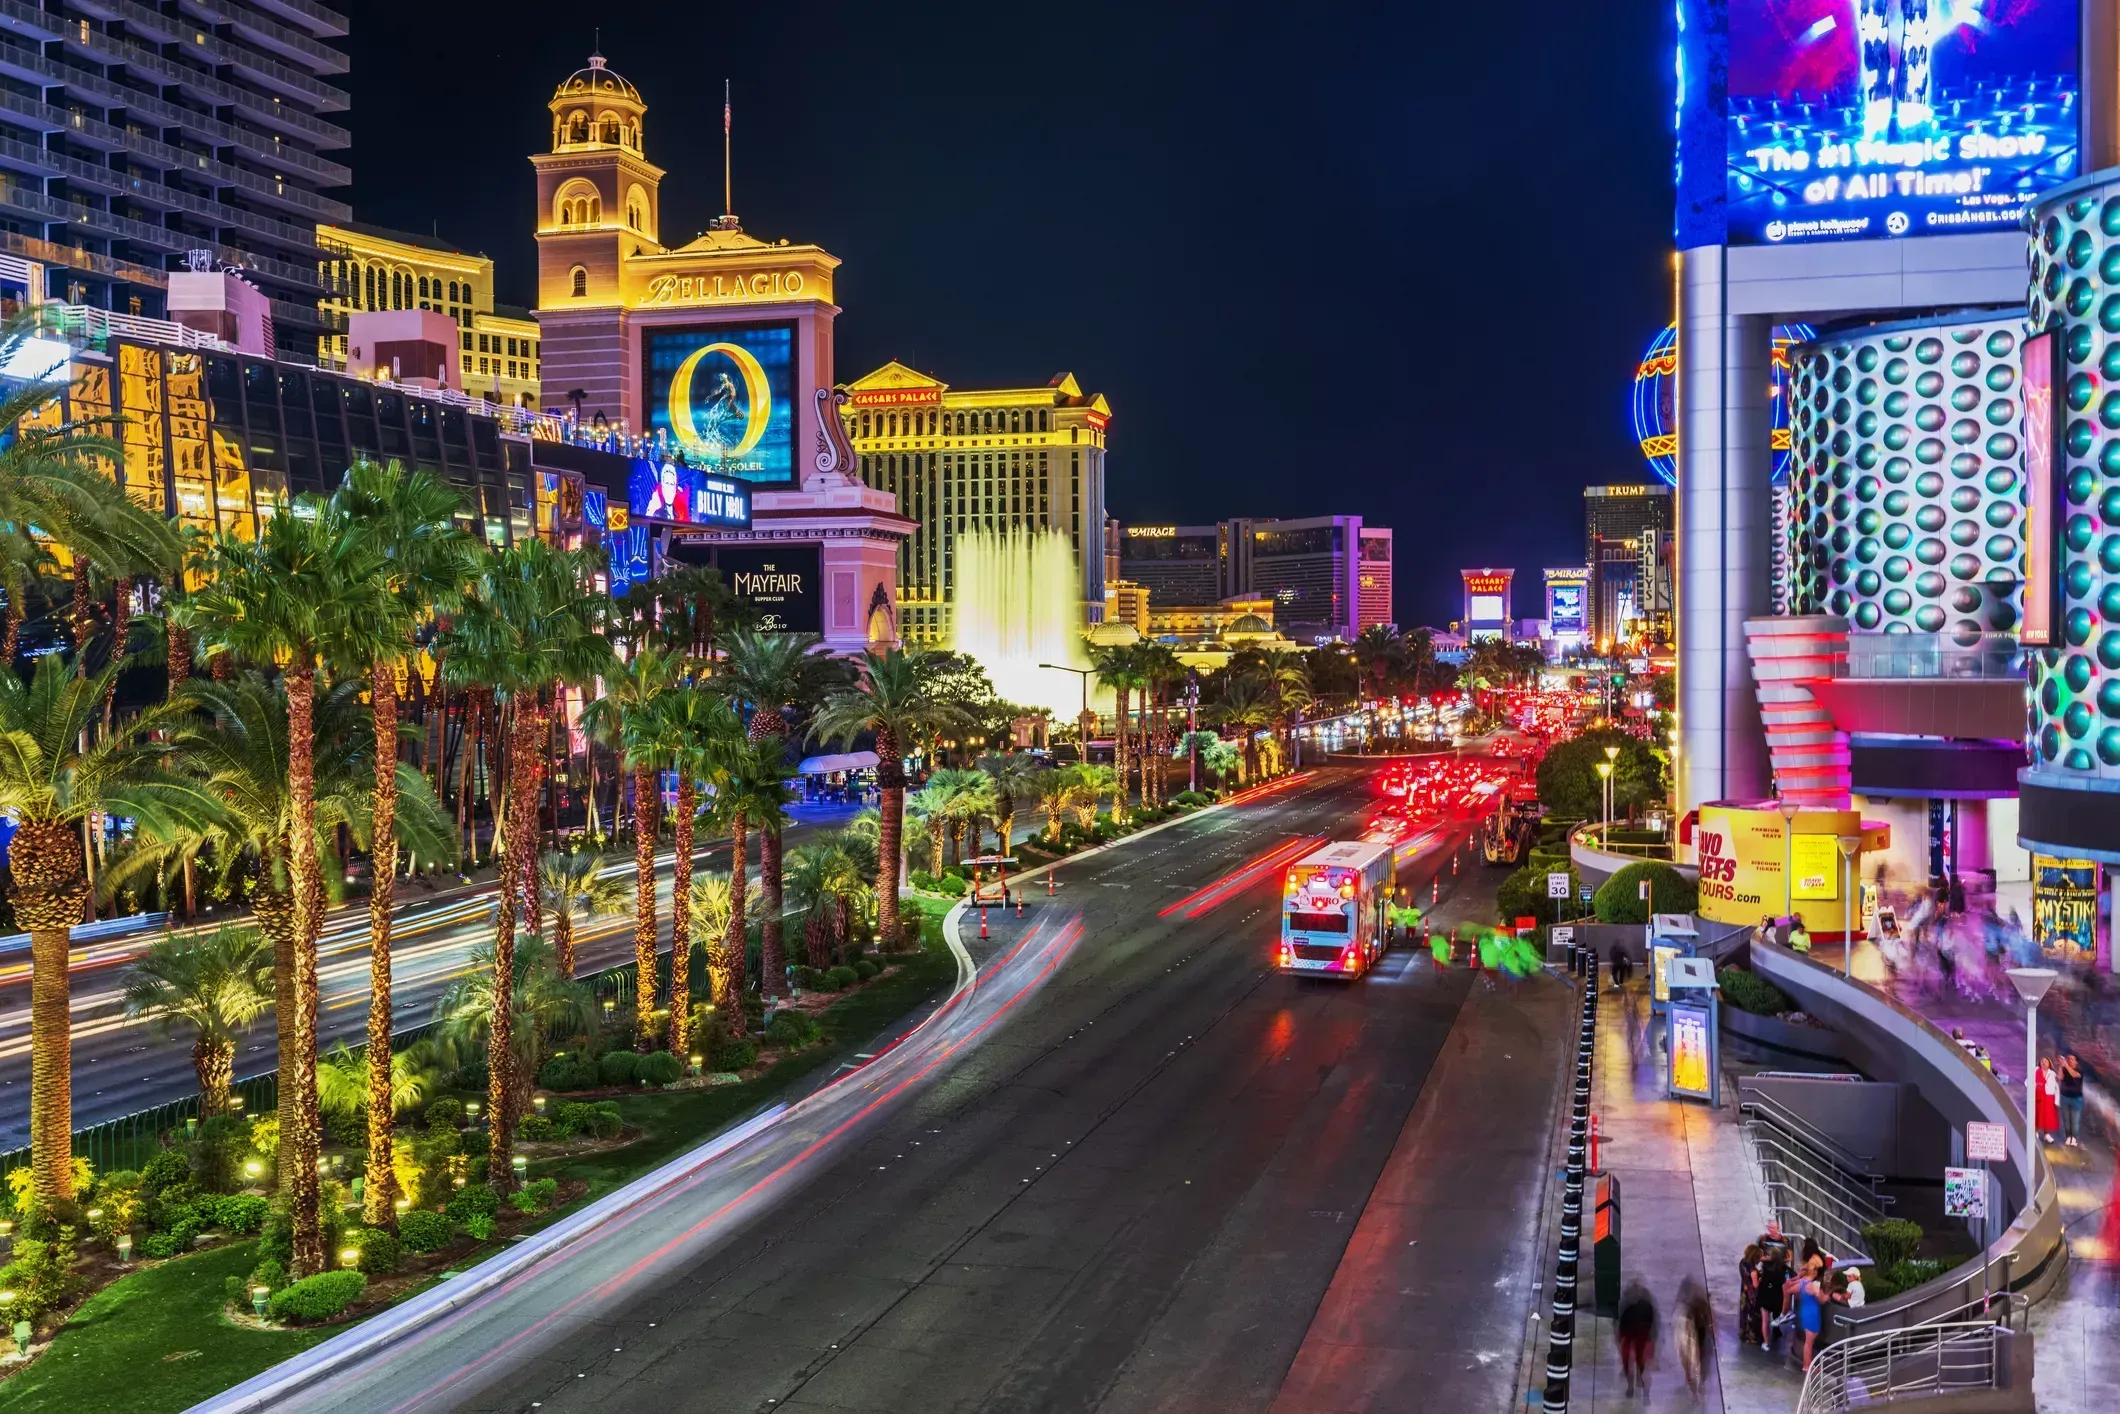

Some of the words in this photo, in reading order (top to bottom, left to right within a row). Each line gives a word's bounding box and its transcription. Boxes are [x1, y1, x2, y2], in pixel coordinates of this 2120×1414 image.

[1817, 143, 1850, 168] #1
[1854, 136, 1949, 167] Magic
[1960, 131, 2046, 160] Show
[1804, 175, 1839, 202] of
[1846, 173, 1887, 198] All
[1962, 196, 1980, 205] Las
[639, 272, 804, 304] BELLAGIO
[668, 342, 772, 457] O
[855, 393, 897, 405] CAESARS
[900, 391, 937, 402] PALACE
[731, 461, 765, 472] SOLEIL
[1608, 486, 1645, 496] TRUMP
[697, 490, 723, 516] BILLY
[725, 495, 746, 520] IDOL
[1136, 526, 1176, 537] MIRAGE
[763, 564, 775, 572] THE
[1553, 569, 1589, 579] MIRAGE
[734, 572, 803, 596] MAYFAIR
[1470, 577, 1505, 585] CAESARS
[1552, 886, 1567, 895] 30
